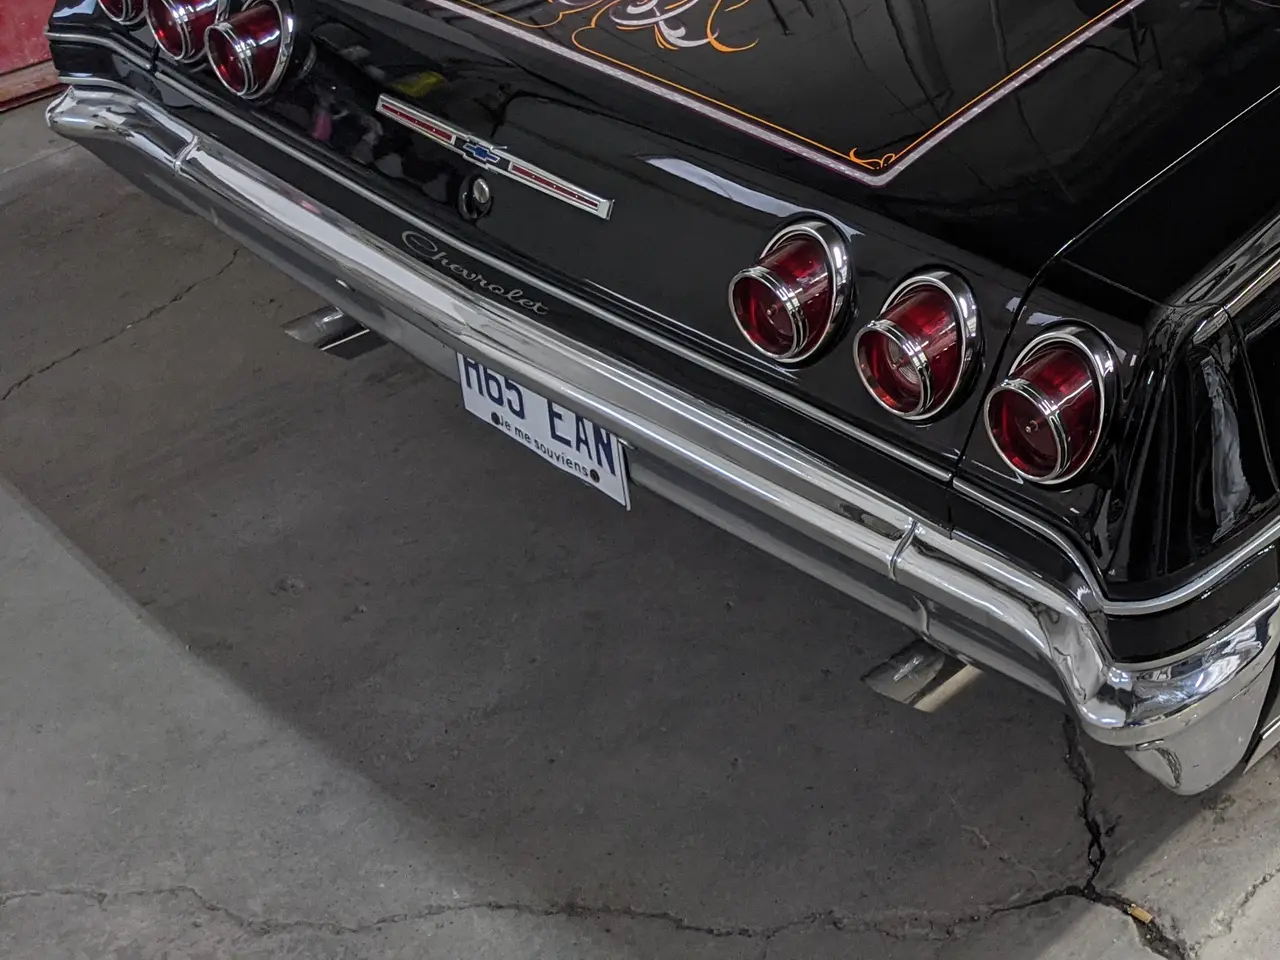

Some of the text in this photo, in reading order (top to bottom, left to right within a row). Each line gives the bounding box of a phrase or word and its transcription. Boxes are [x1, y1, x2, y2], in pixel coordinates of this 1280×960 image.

[401, 230, 549, 315] Chevrolet
[514, 427, 532, 444] me
[534, 438, 589, 477] souviens
[547, 398, 617, 477] EAN
